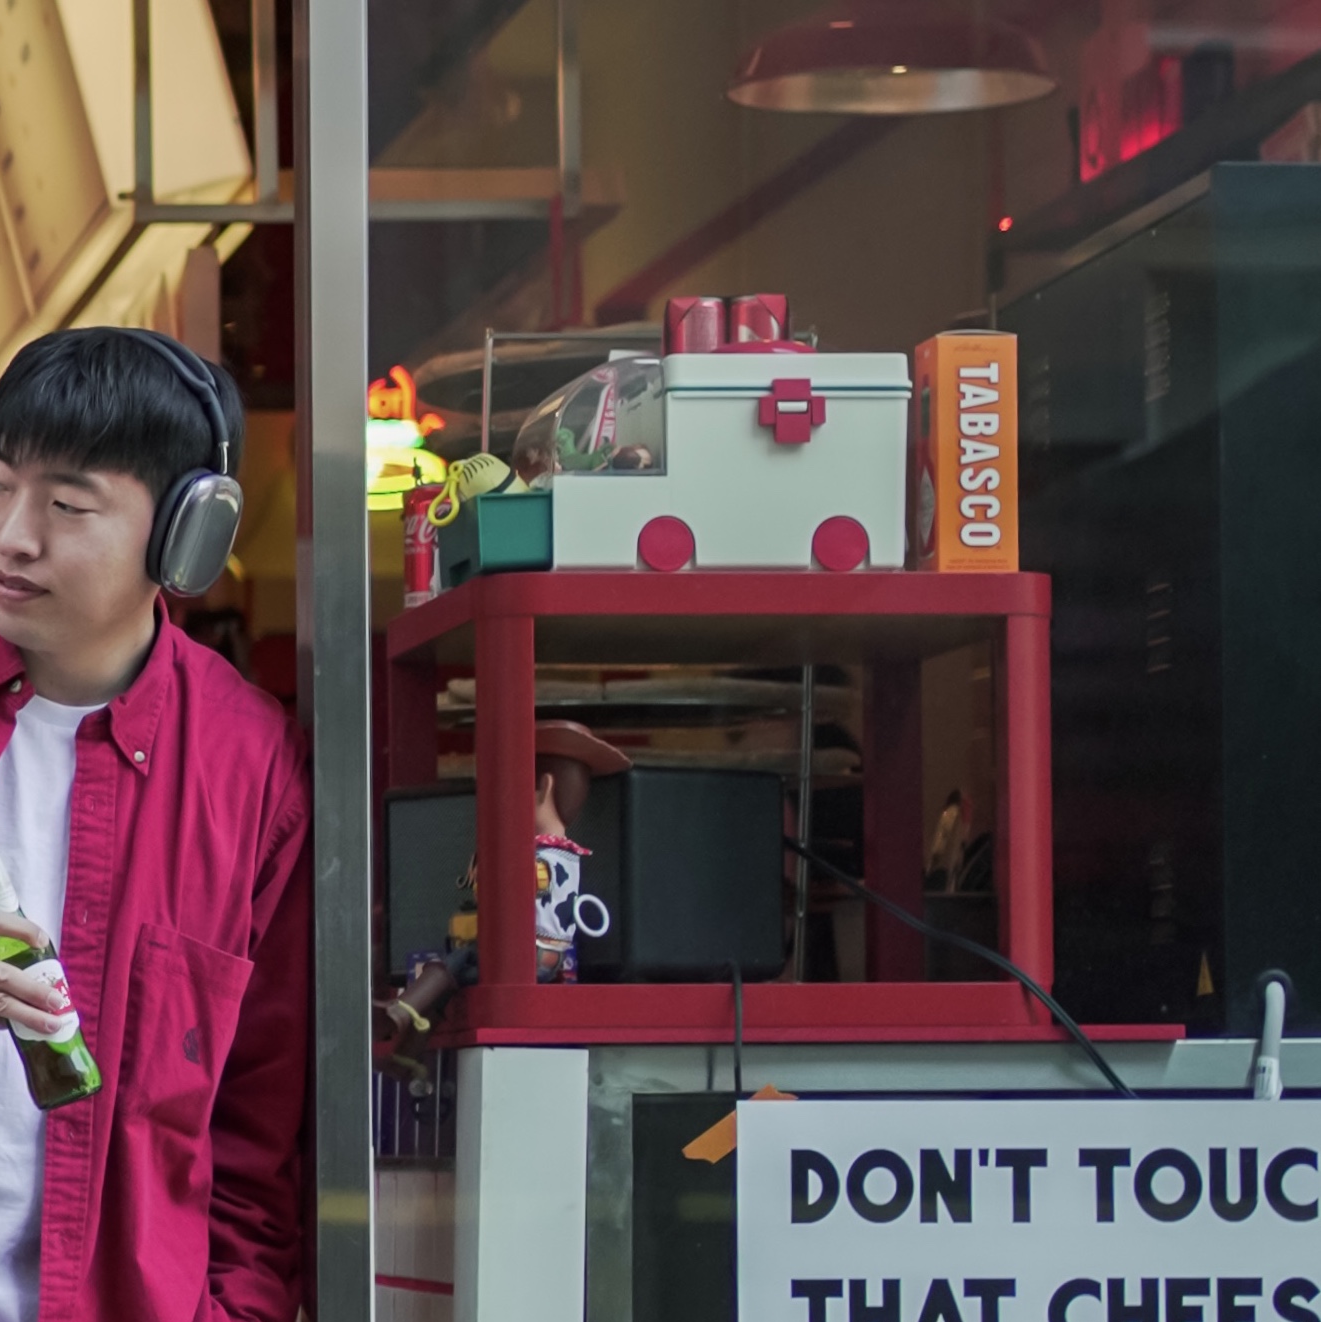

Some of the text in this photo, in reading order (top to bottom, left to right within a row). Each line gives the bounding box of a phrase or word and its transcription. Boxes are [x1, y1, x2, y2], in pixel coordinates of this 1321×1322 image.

[959, 362, 1001, 547] TABASCO
[790, 1147, 1319, 1224] DON'T TOUC
